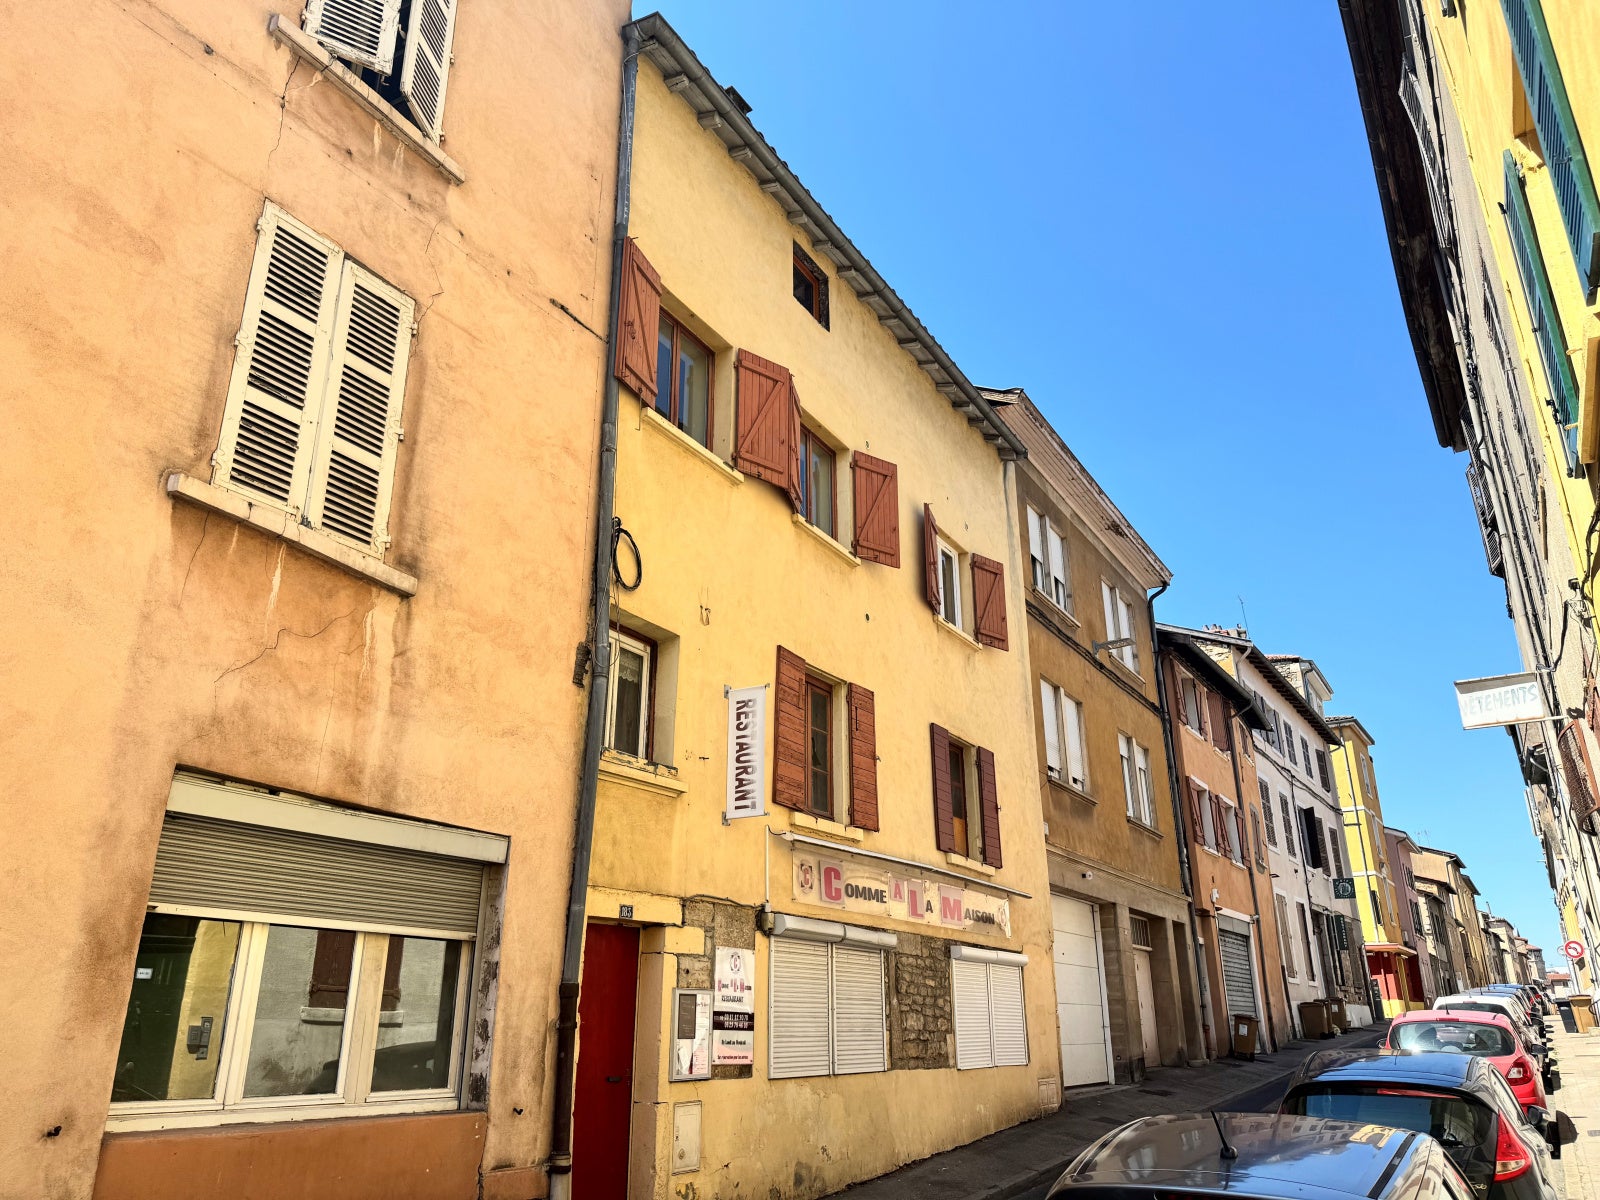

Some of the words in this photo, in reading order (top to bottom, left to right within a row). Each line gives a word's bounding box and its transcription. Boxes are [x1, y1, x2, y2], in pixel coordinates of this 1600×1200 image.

[735, 698, 758, 810] RESTAURANT
[823, 866, 887, 904] COMME
[909, 889, 934, 918] LA
[941, 896, 995, 925] MAISON
